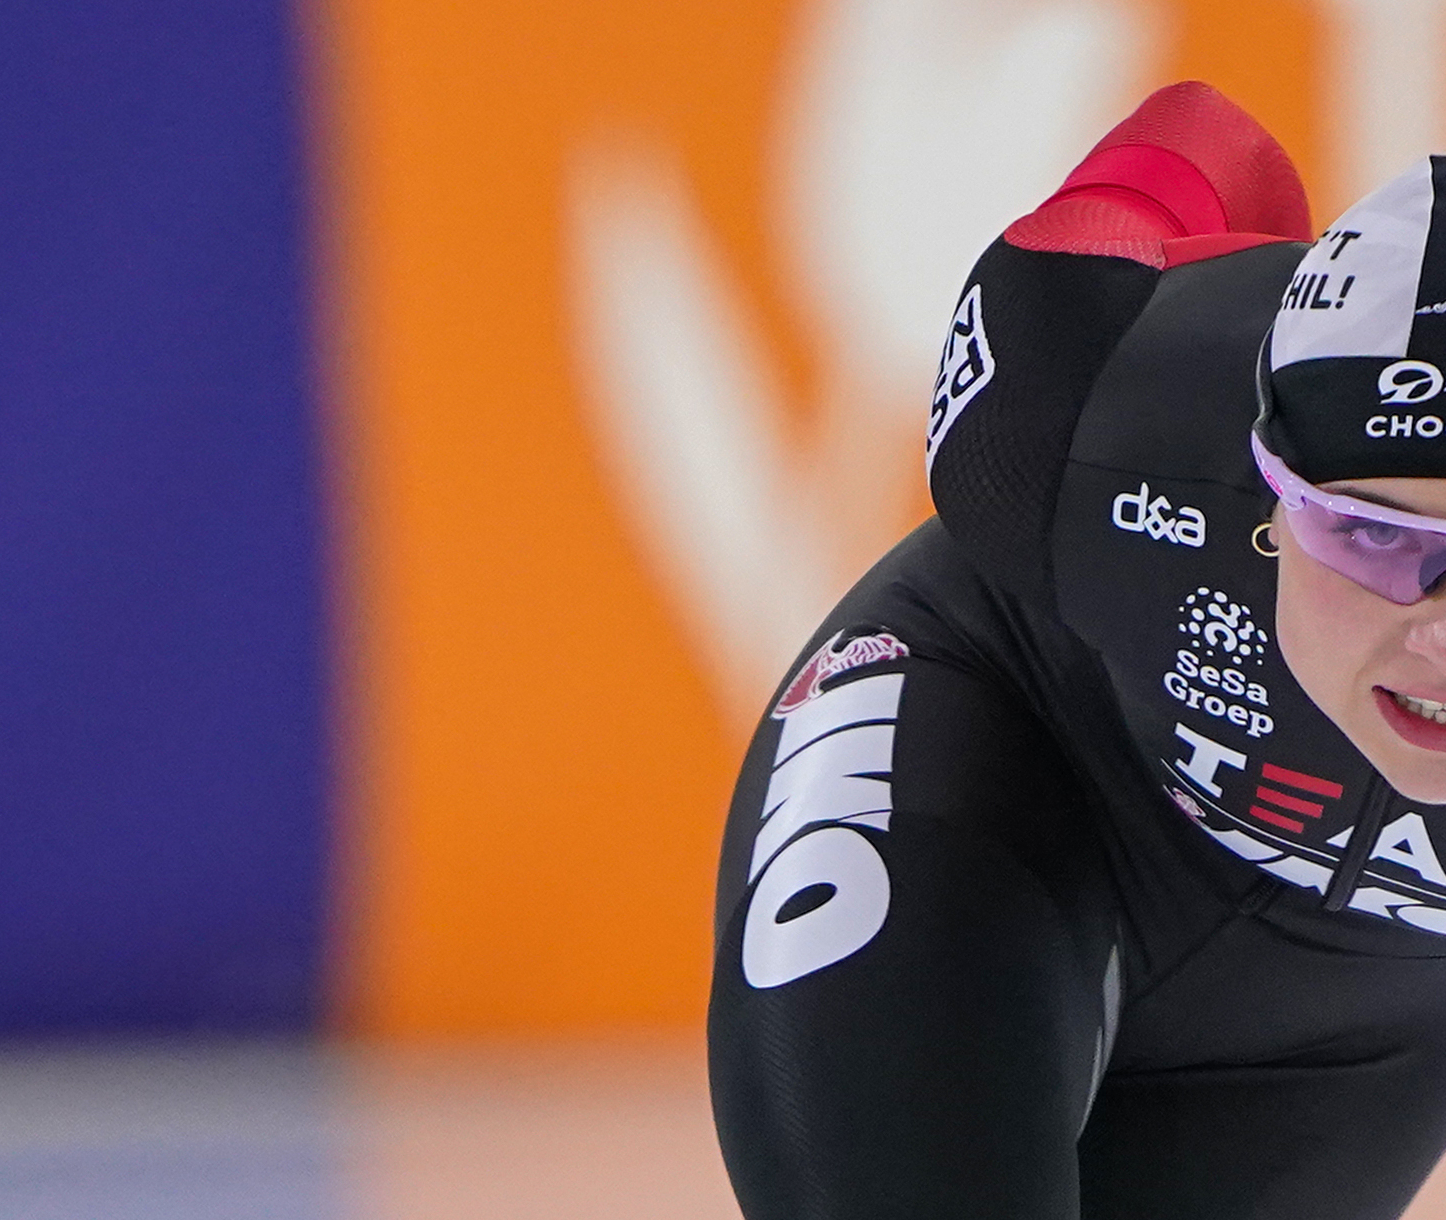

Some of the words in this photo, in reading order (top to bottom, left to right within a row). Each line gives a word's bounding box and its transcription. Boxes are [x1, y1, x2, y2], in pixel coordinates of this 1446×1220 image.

[1112, 482, 1206, 547] d&a
[1163, 671, 1275, 738] Groep
[1176, 649, 1269, 706] SeSa
